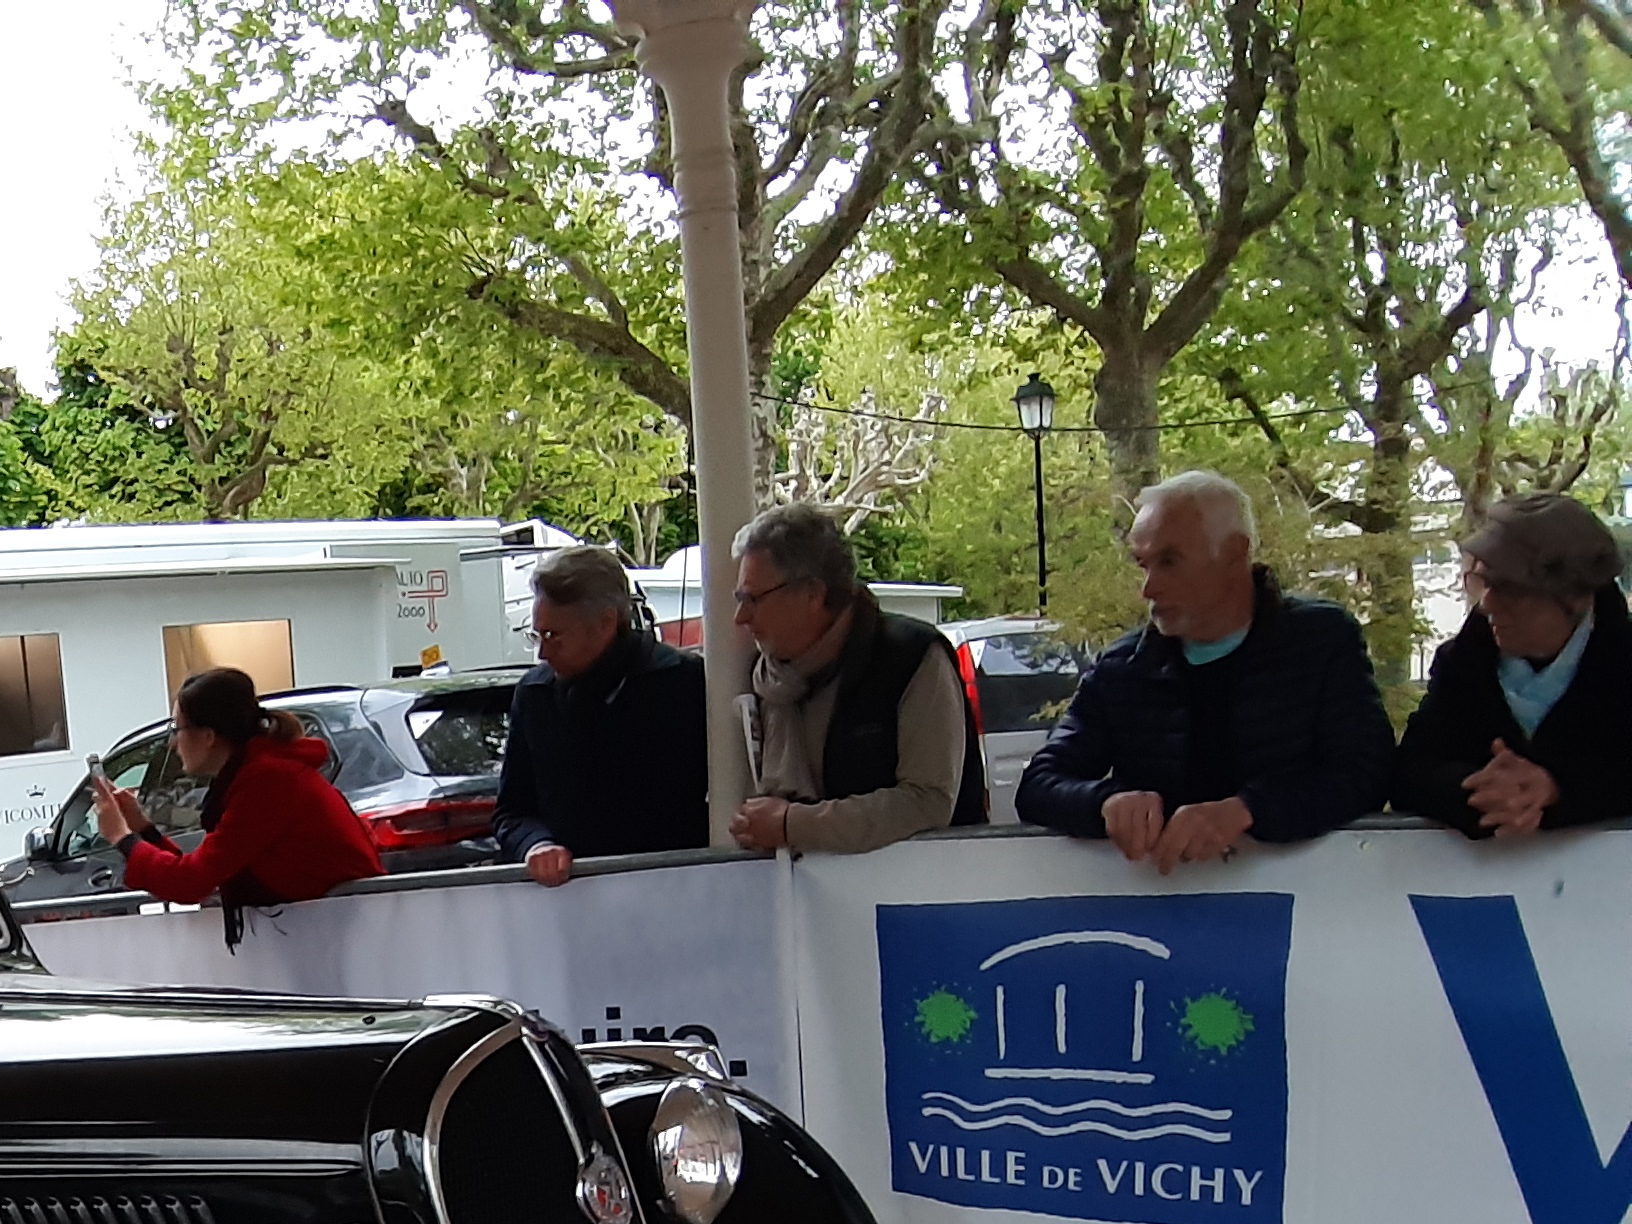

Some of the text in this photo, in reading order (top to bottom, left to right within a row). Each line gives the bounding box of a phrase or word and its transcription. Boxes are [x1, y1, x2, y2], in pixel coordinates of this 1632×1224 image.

[397, 603, 426, 618] 2000
[908, 1141, 1263, 1206] VILLE DE VICHY
